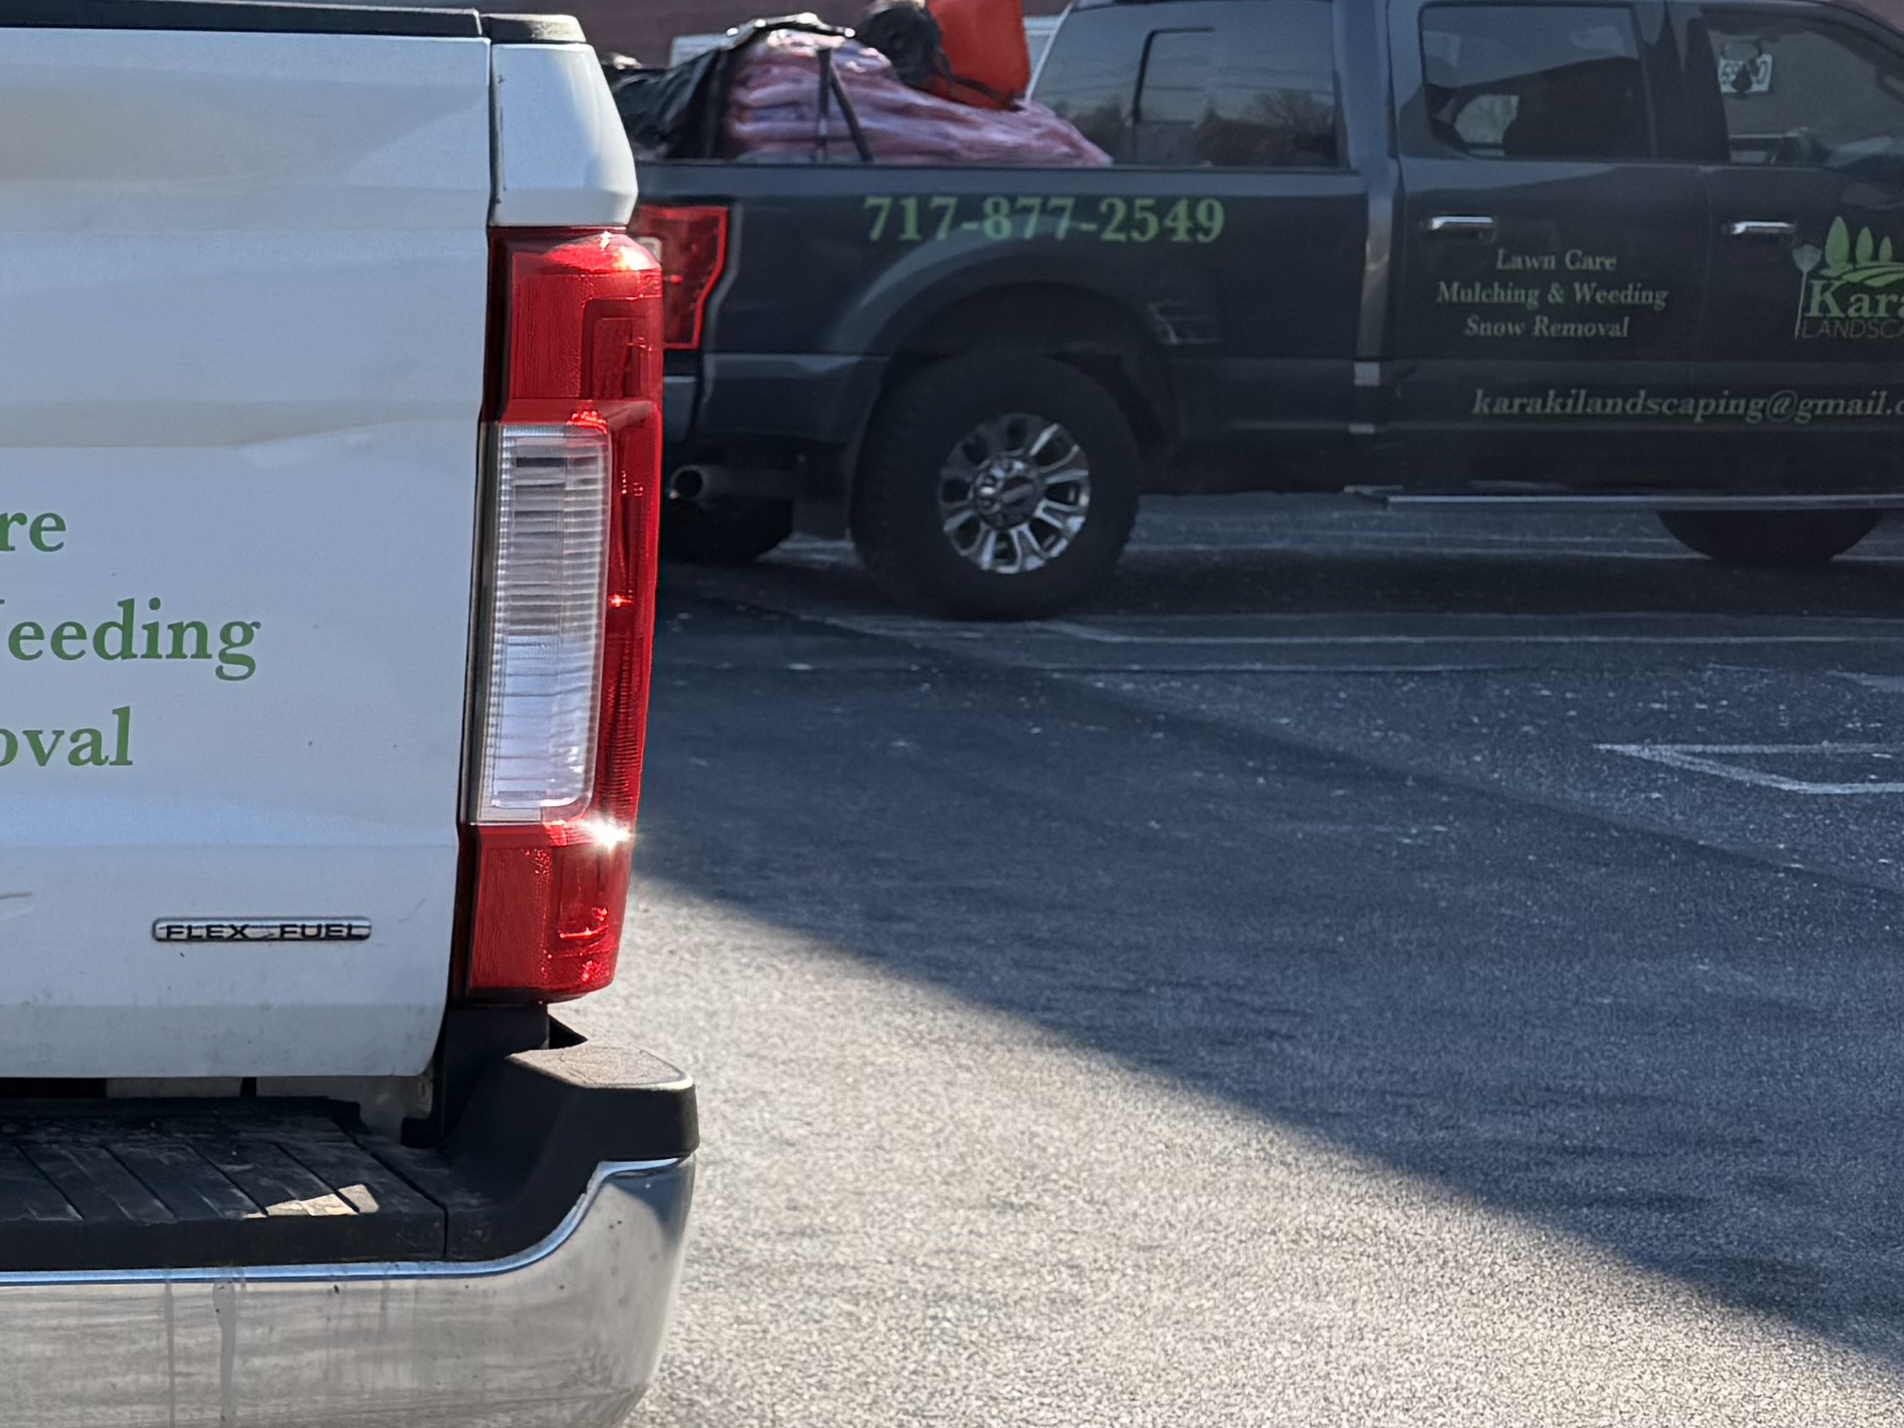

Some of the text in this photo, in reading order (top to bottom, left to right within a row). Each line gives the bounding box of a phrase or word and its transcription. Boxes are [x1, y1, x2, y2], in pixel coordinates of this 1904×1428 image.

[862, 195, 1225, 244] 717-877-2549
[1495, 248, 1618, 272] Lawn Care
[1436, 280, 1669, 312] Mulching & Weeding
[1804, 279, 1904, 319] Kar
[1464, 315, 1630, 338] Snow Removal
[1801, 319, 1904, 339] LANDSC
[165, 922, 368, 941] FLEX FUEL
